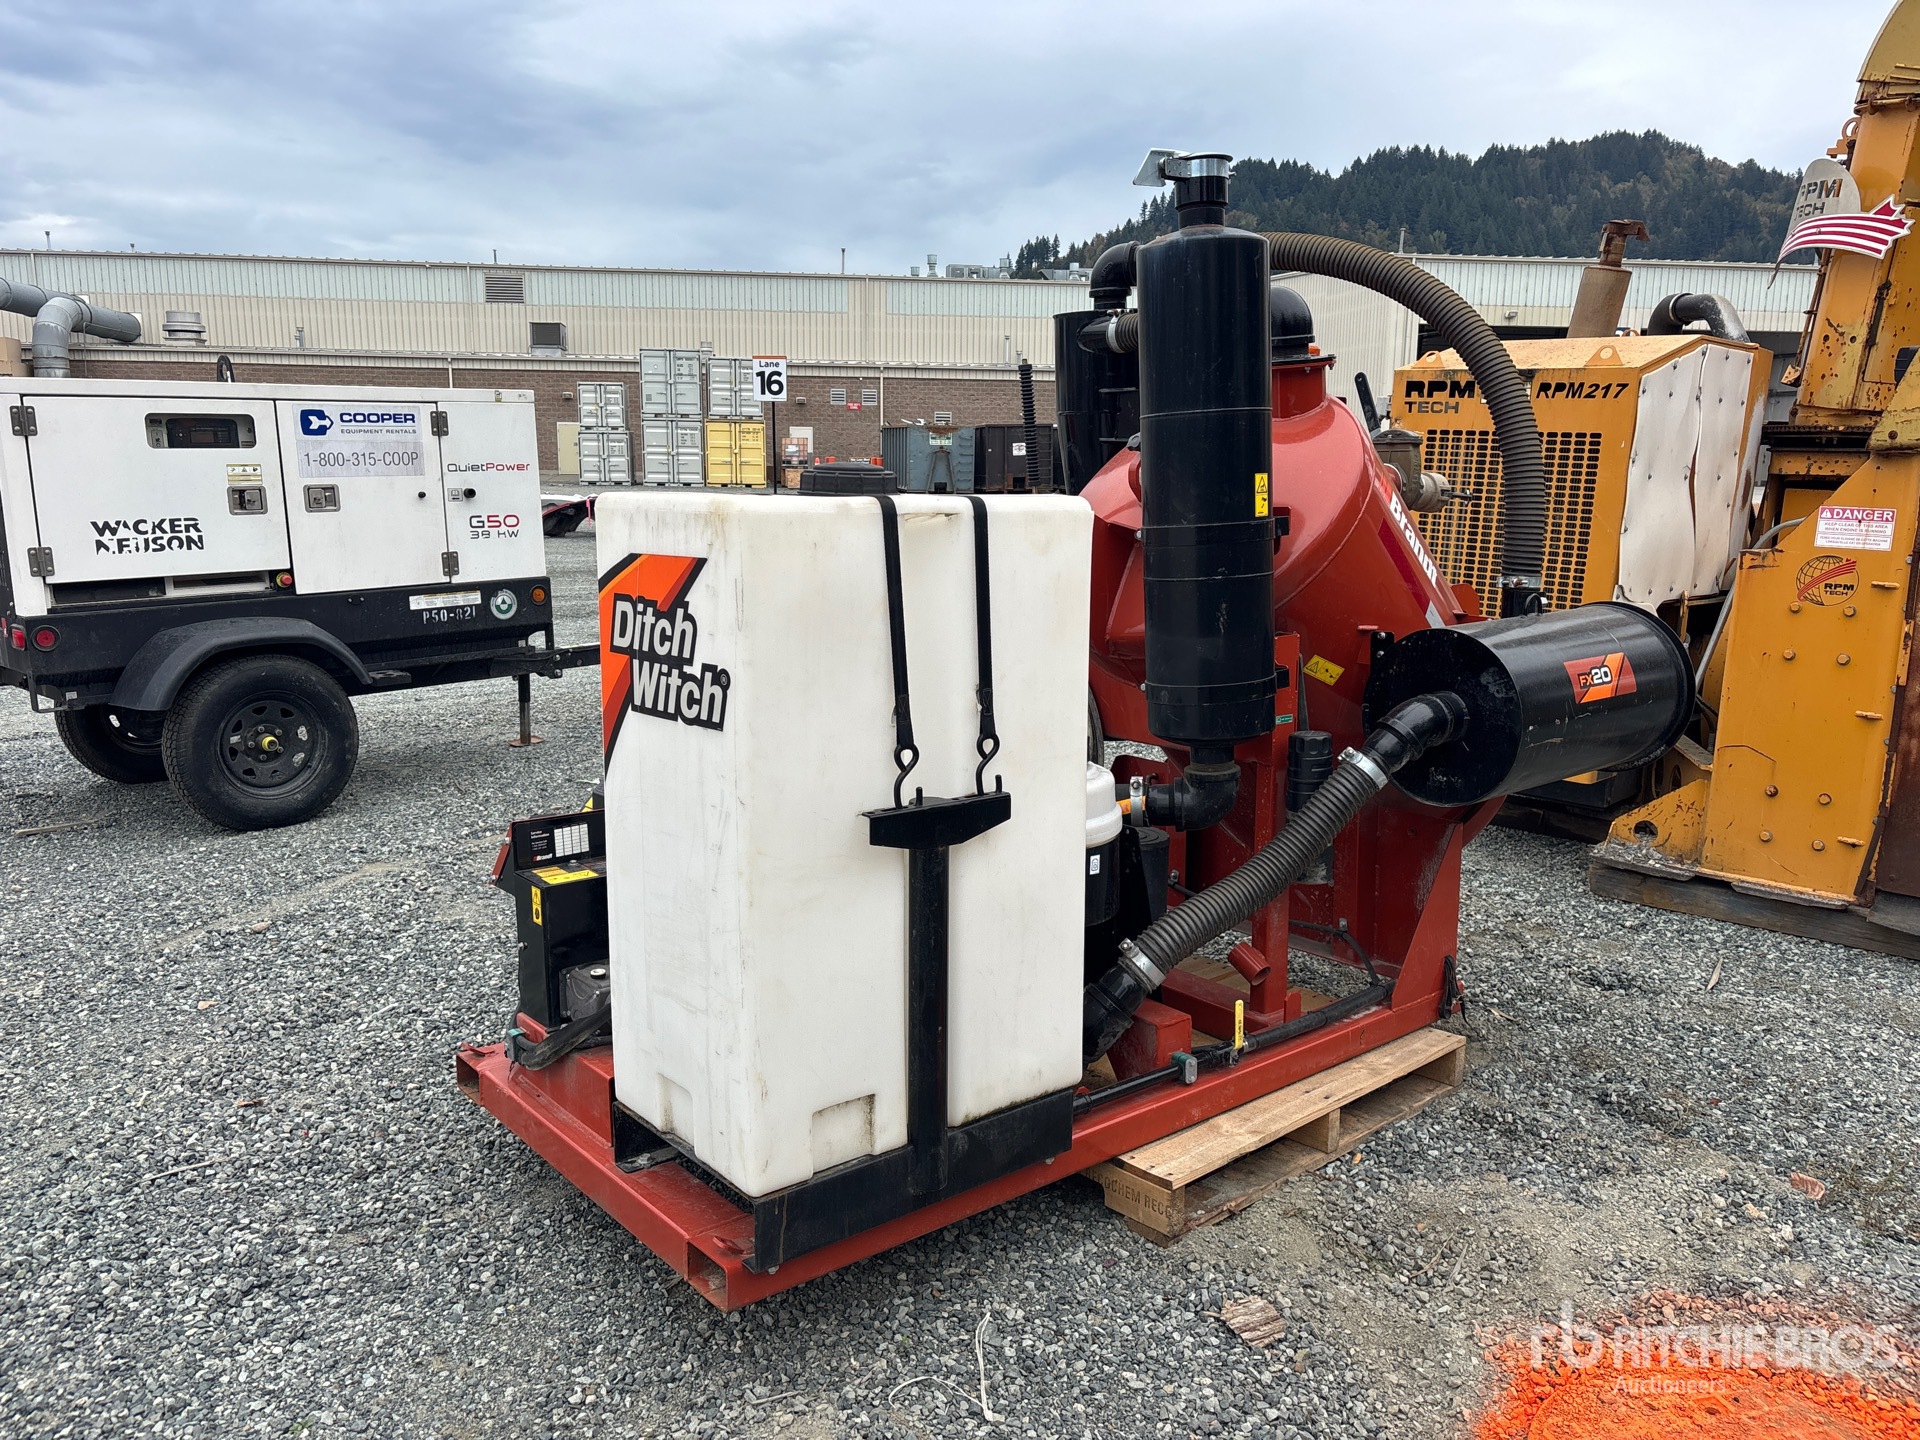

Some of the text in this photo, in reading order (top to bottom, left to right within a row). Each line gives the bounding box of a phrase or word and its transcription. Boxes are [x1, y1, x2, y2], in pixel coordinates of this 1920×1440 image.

[1794, 202, 1825, 220] ECH
[756, 370, 784, 396] 16
[1405, 380, 1476, 398] RPM
[1536, 382, 1630, 398] RPM217
[1405, 401, 1459, 413] TECH
[339, 412, 416, 424] COOPER
[304, 451, 418, 468] 1-800-315-COOP
[447, 462, 530, 472] QuietPower
[469, 514, 520, 529] G50
[1833, 508, 1892, 522] DANGER
[470, 530, 490, 539] 38
[1824, 583, 1854, 591] RPM
[613, 600, 694, 659] Ditch
[1580, 666, 1612, 686] FX20
[632, 658, 724, 723] Witch
